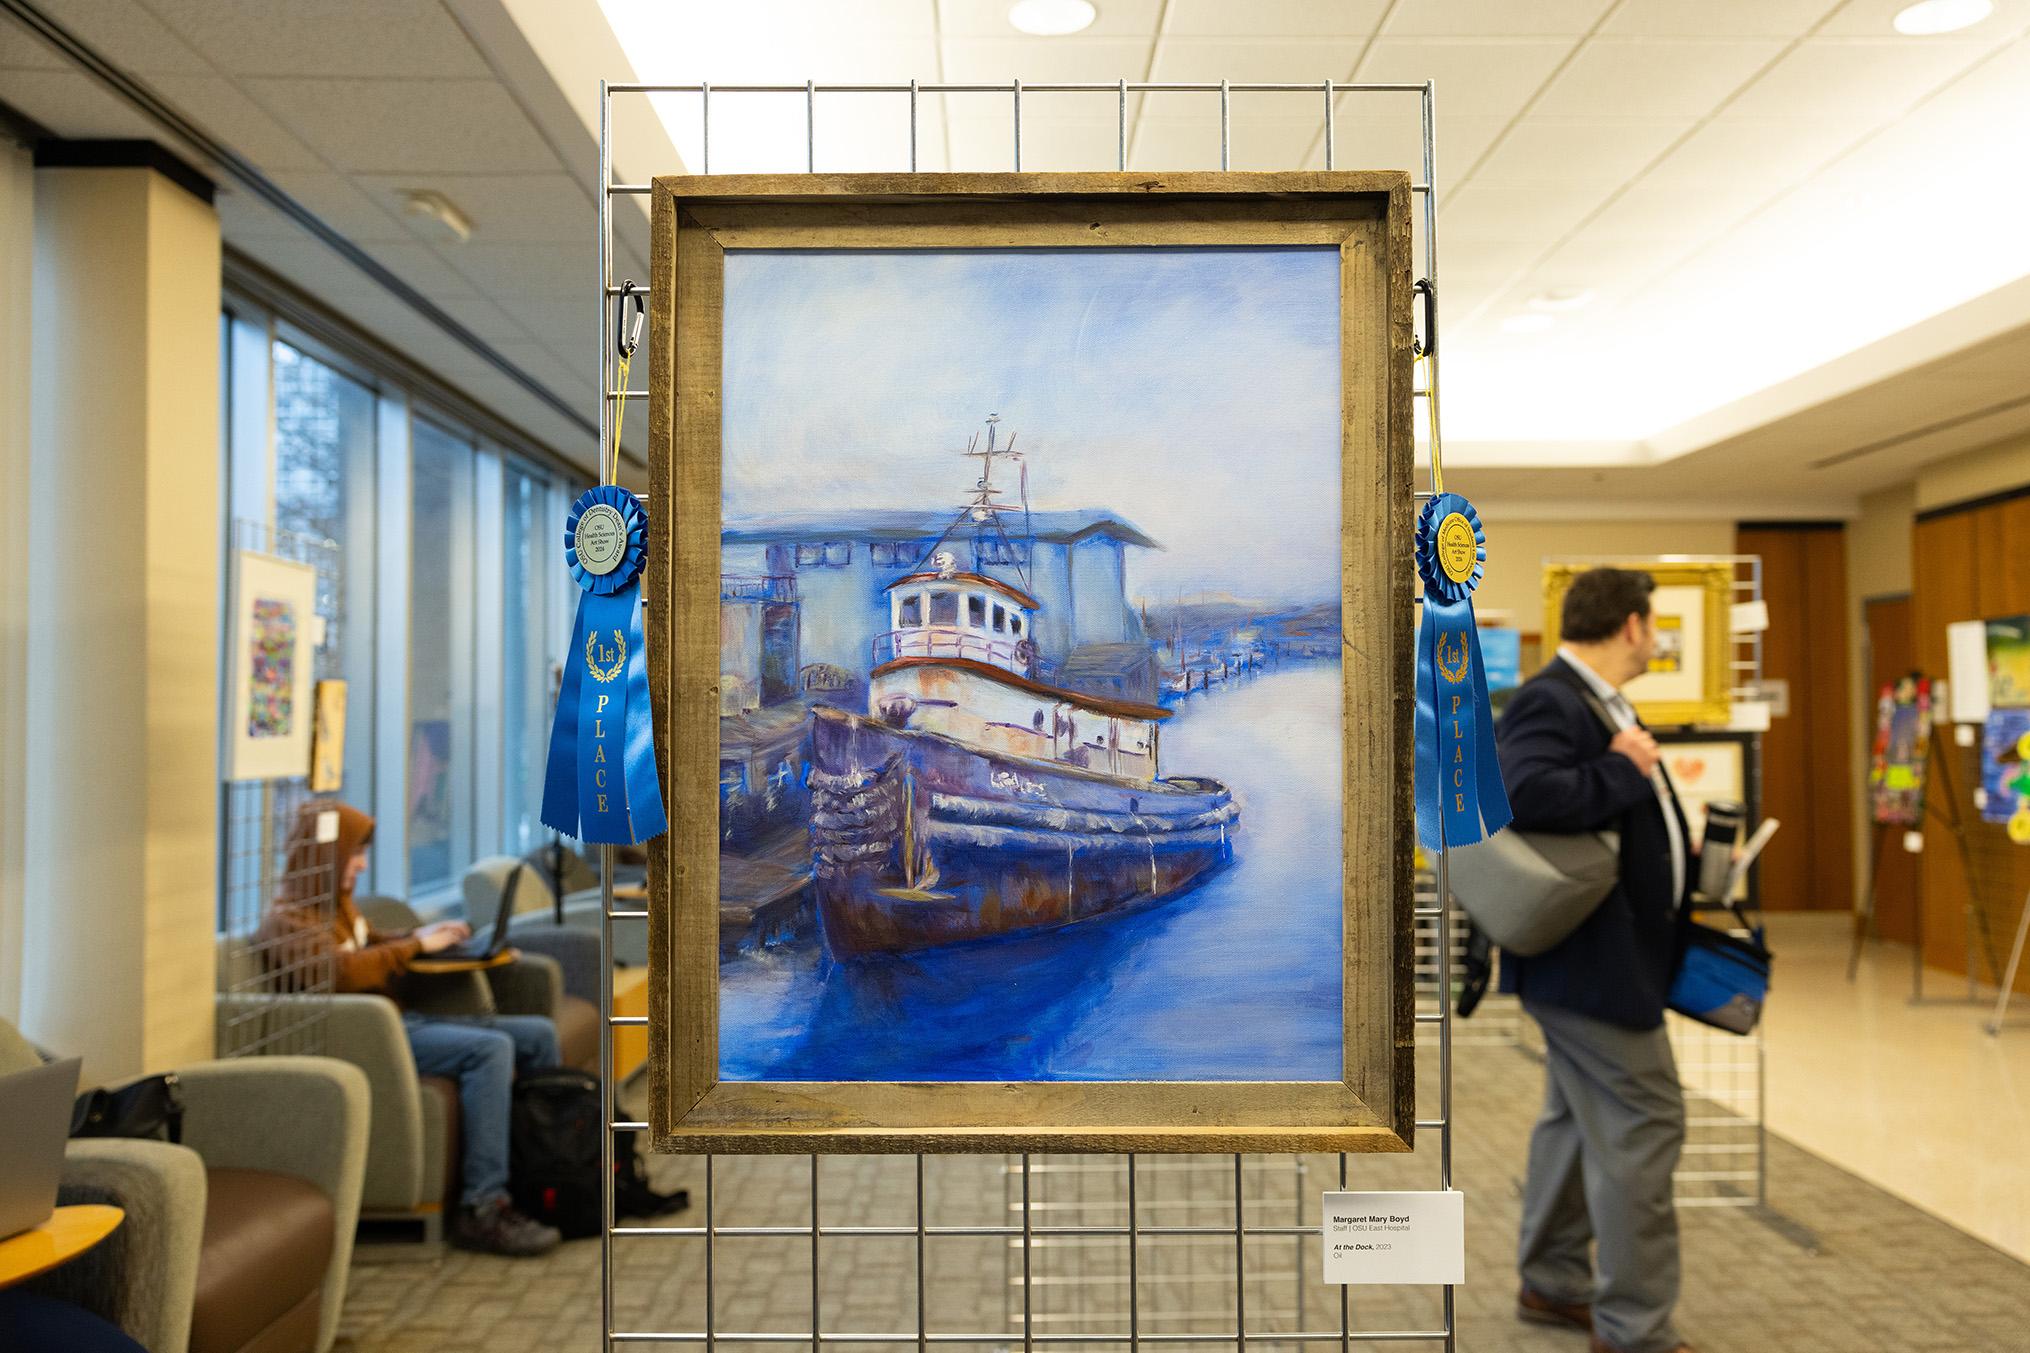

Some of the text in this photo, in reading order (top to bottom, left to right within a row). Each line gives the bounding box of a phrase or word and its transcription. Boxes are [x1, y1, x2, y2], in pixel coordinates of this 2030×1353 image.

[588, 506, 612, 517] Dentistry
[612, 511, 625, 536] Dean's
[576, 521, 584, 548] College
[578, 549, 588, 564] OSU
[612, 539, 624, 562] Award
[598, 644, 615, 663] 1st
[1447, 645, 1460, 664] 1st
[594, 695, 609, 813] PLACE
[1452, 696, 1465, 812] PLACE
[1333, 1215, 1410, 1224] Margaret Mary Boyd
